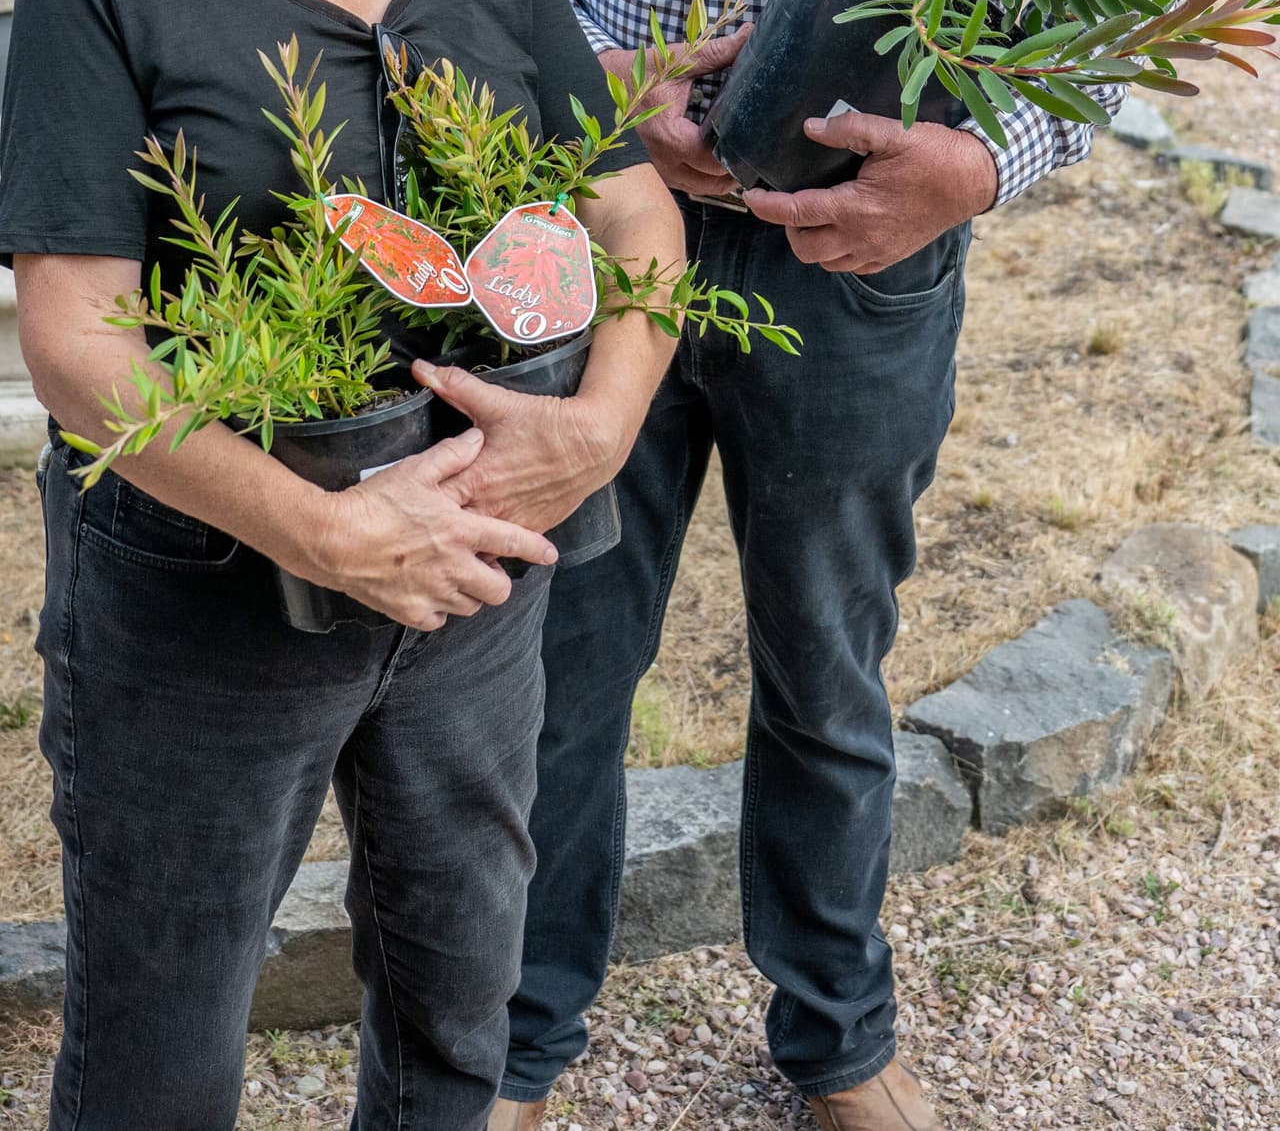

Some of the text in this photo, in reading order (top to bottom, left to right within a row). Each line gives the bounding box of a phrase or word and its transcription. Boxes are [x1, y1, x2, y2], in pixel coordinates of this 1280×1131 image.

[524, 214, 573, 238] Grevillea
[406, 259, 438, 293] Lady
[484, 275, 543, 309] Lady
